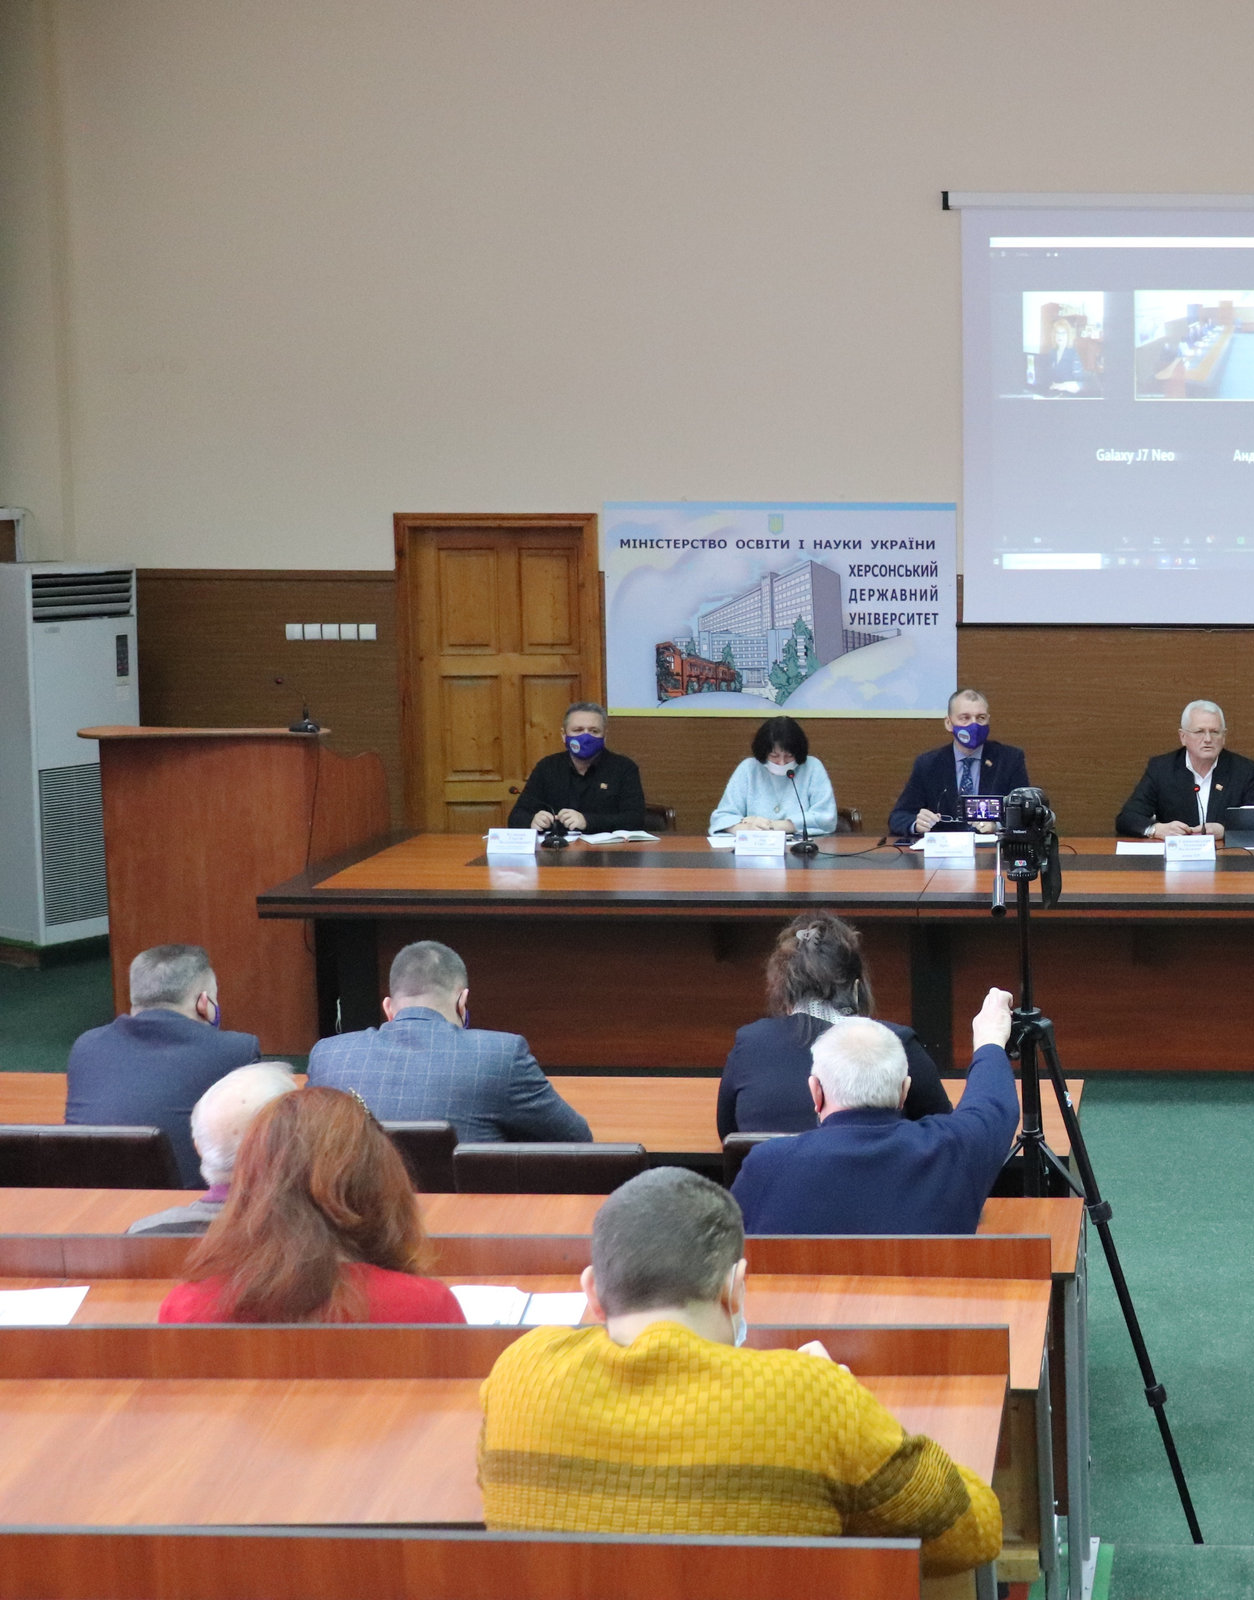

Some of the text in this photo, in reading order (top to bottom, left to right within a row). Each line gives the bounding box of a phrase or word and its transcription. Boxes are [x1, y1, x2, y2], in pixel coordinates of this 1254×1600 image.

[1096, 448, 1176, 464] Galaxy J7 Neo
[619, 537, 936, 550] МІНІСТЕРСТВО ОСВІТИ І НАУКИ УКРАЇНИ
[848, 561, 938, 578] ХЕРСОНСЬКИЙ
[848, 585, 939, 604] ДЕРЖАВНИЙ
[848, 612, 939, 626] УНІВЕРСИТЕТ
